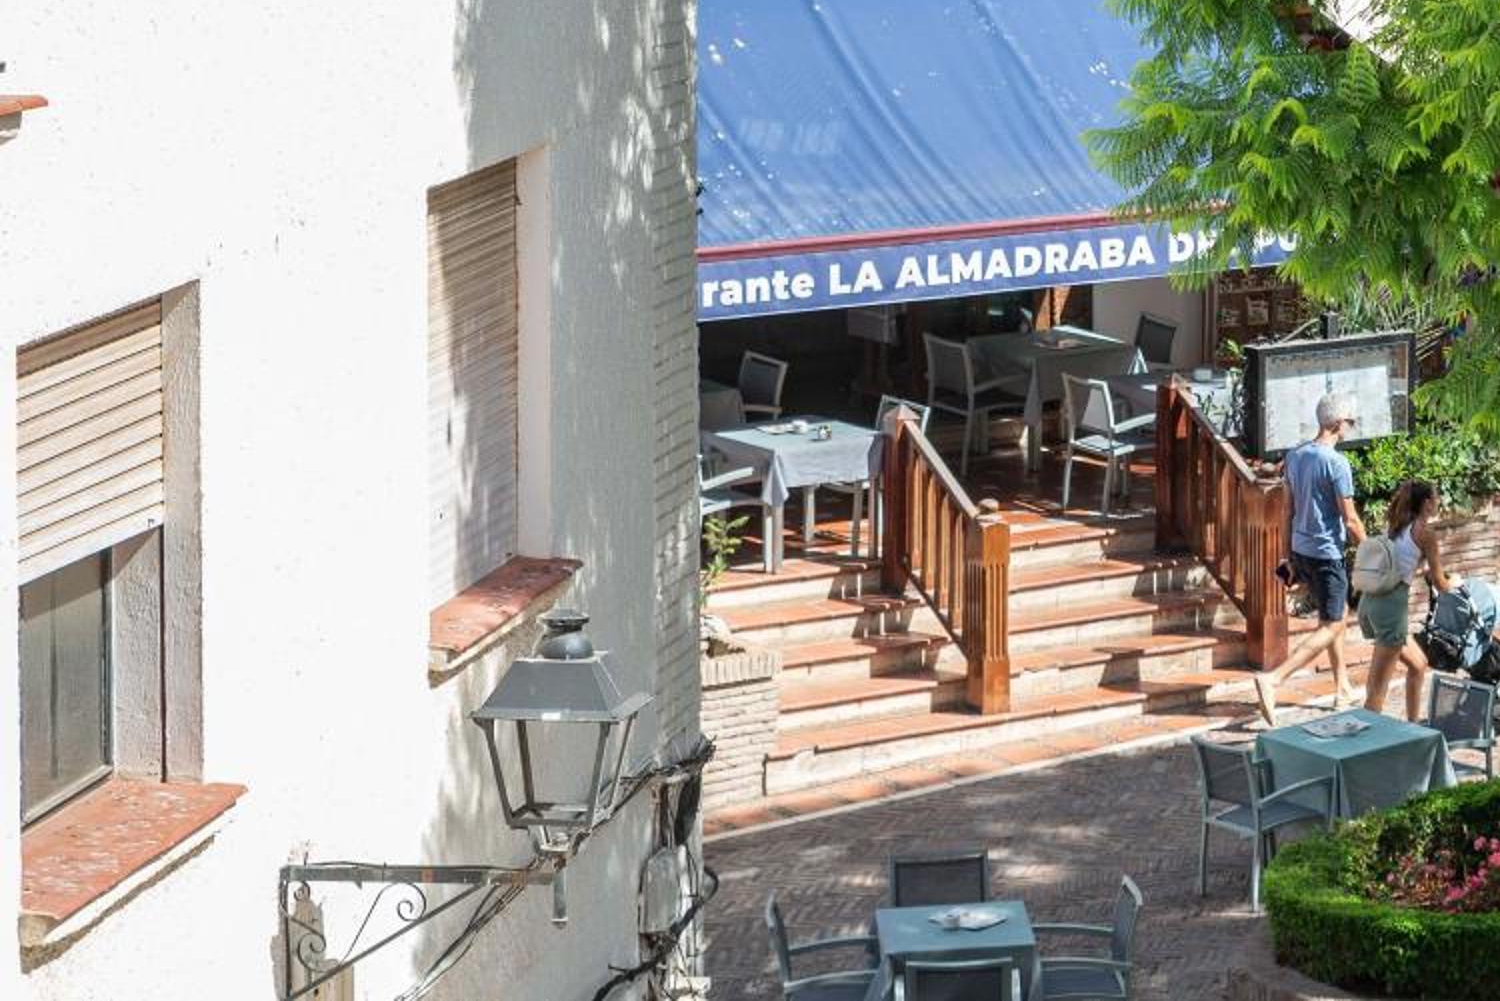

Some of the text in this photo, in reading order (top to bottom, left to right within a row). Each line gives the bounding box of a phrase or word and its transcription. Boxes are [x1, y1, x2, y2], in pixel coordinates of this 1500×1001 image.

[702, 269, 815, 307] rante
[829, 260, 883, 296] LA
[895, 235, 1155, 288] ALMADRABA
